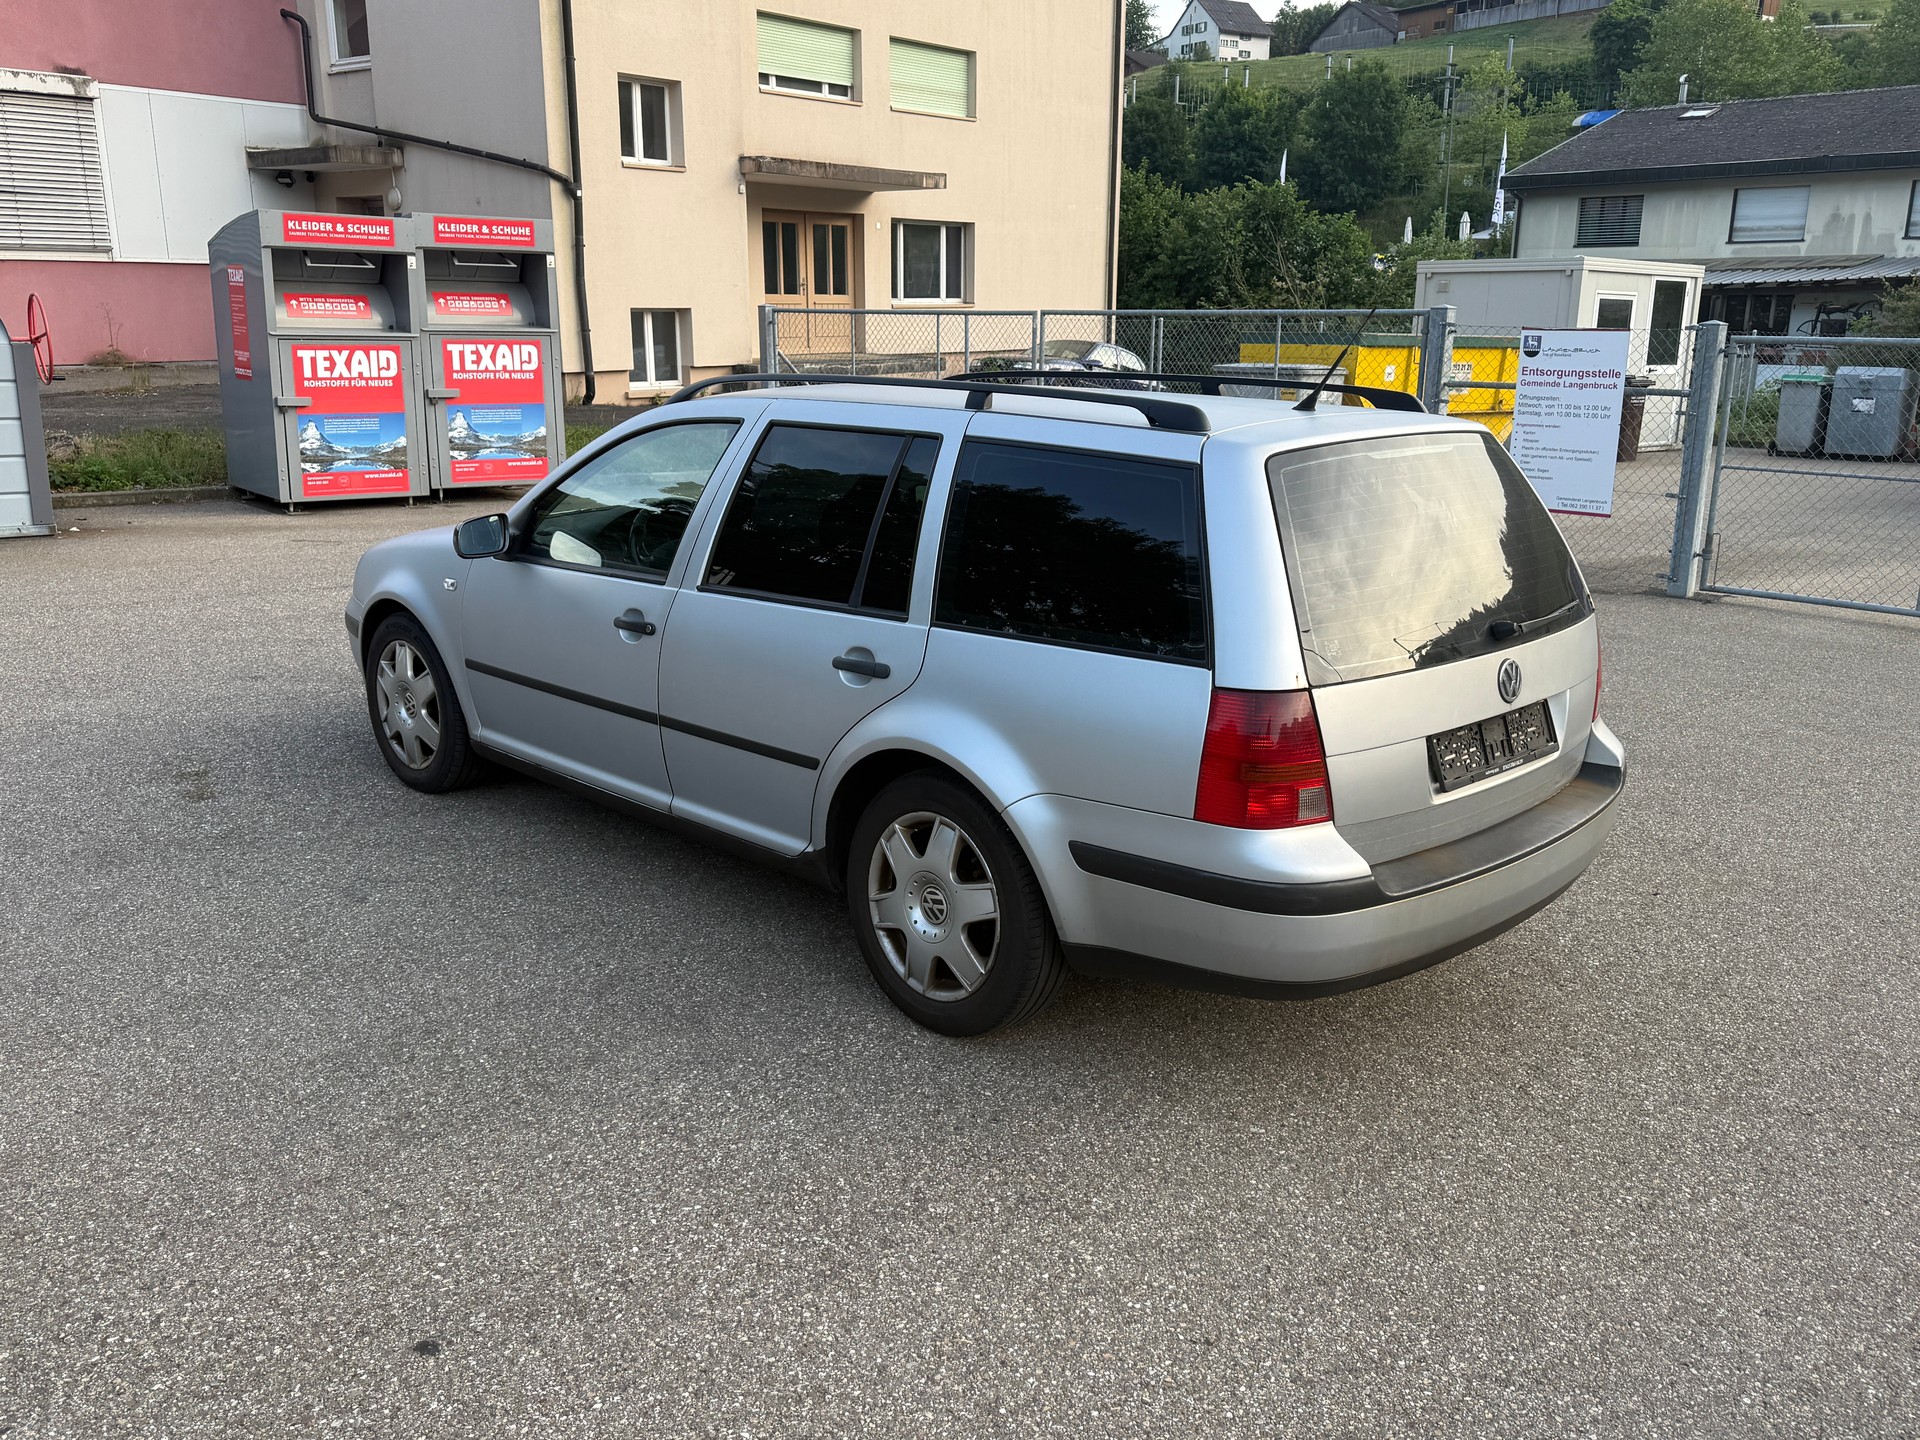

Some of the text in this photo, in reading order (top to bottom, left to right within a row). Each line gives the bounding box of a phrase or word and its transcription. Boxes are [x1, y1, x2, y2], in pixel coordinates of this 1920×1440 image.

[288, 220, 390, 234] KLEIDER & SCHUHE
[438, 223, 531, 235] KLEIDER & SCHUHE
[446, 344, 539, 370] TEXAID
[296, 350, 398, 378] TEXAID
[496, 371, 510, 379] FÜR
[1522, 366, 1622, 379] Entsorgungsstelle
[351, 378, 366, 387] FÜR
[1520, 379, 1618, 390] Gemeinde Langenbruck
